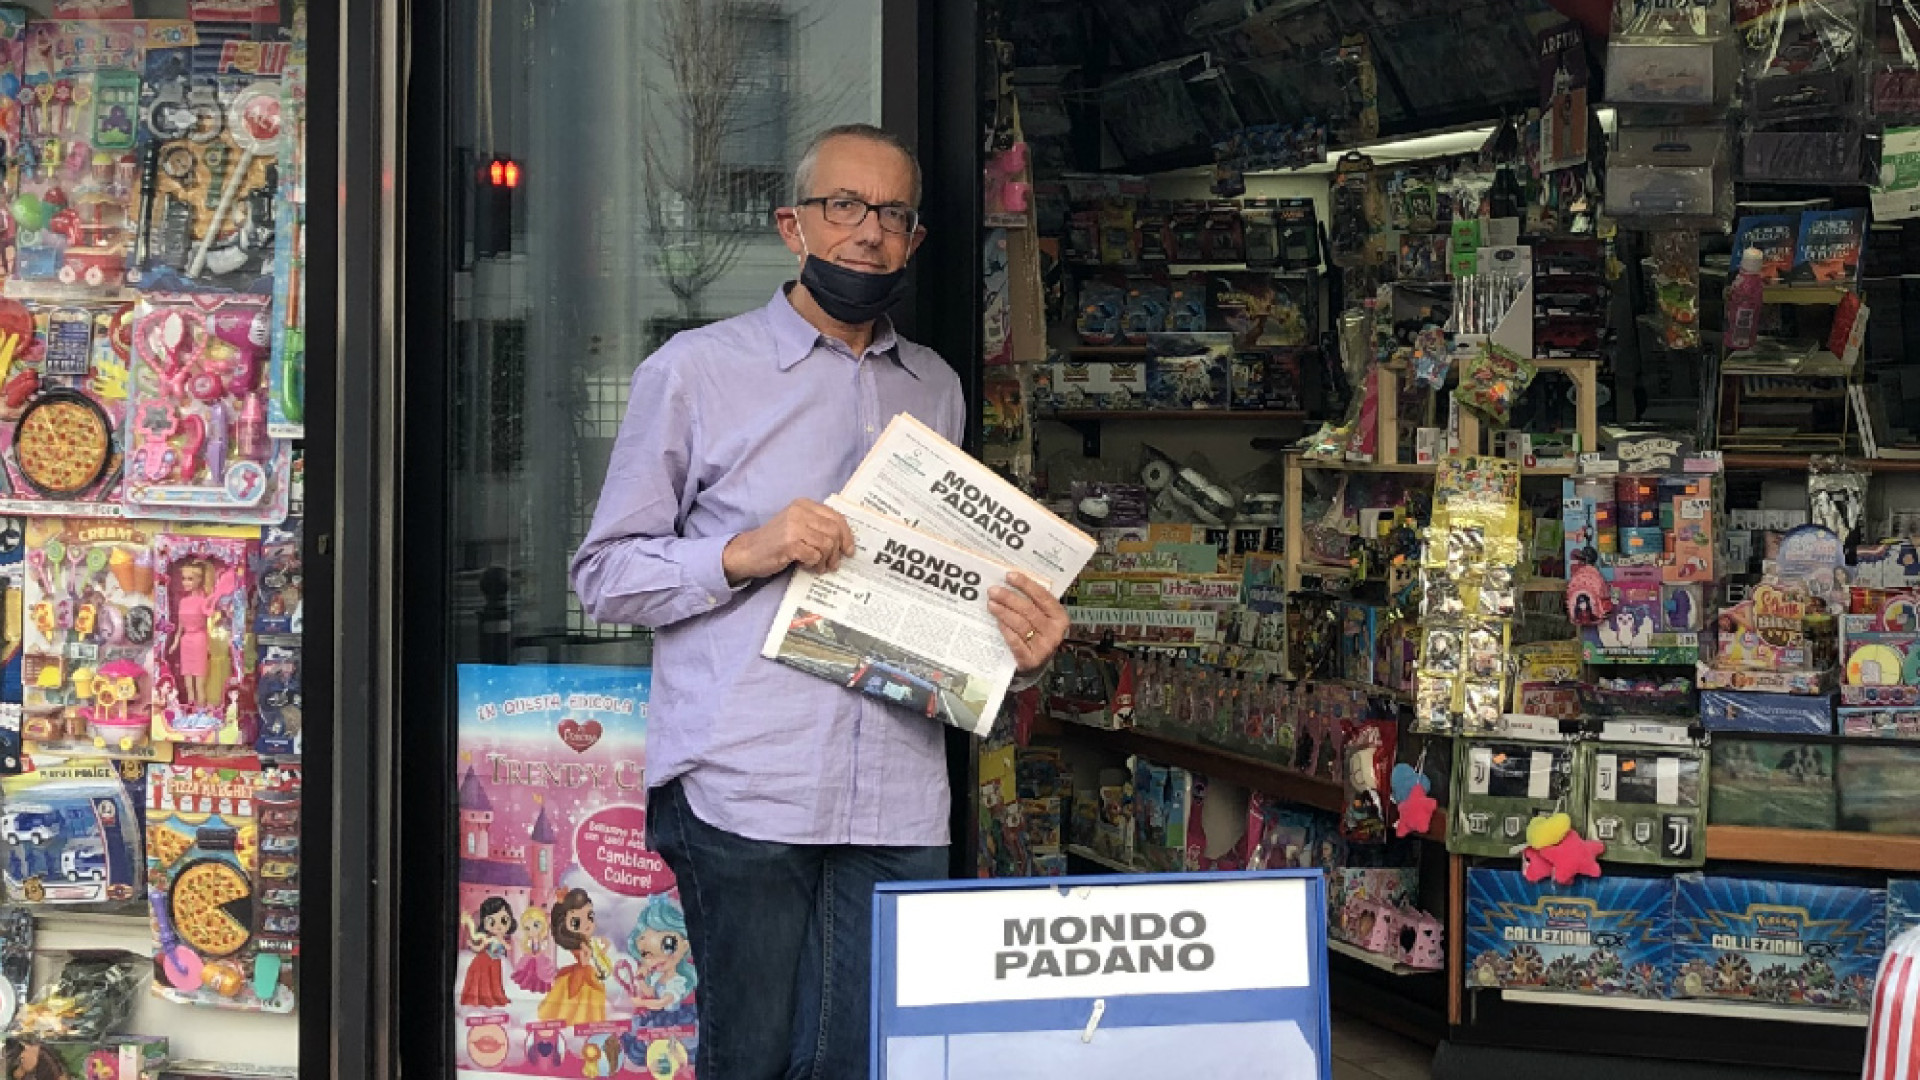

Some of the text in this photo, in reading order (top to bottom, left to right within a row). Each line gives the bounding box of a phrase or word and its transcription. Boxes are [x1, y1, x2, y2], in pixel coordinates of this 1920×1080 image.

[929, 480, 1025, 551] PADANO
[942, 469, 1031, 535] MONDO
[78, 527, 133, 542] CREAM
[873, 552, 979, 601] PADANO
[884, 538, 982, 586] MONDO
[477, 703, 497, 721] IN
[503, 694, 561, 714] QUESTA
[568, 693, 633, 714] EDICOLA
[597, 845, 663, 872] Cambiano
[604, 866, 652, 889] Colore!
[1003, 910, 1207, 947] MONDO
[1504, 925, 1592, 946] COLLEZIONI
[995, 942, 1215, 980] PADANO
[1711, 933, 1804, 957] COLLEZIONI
